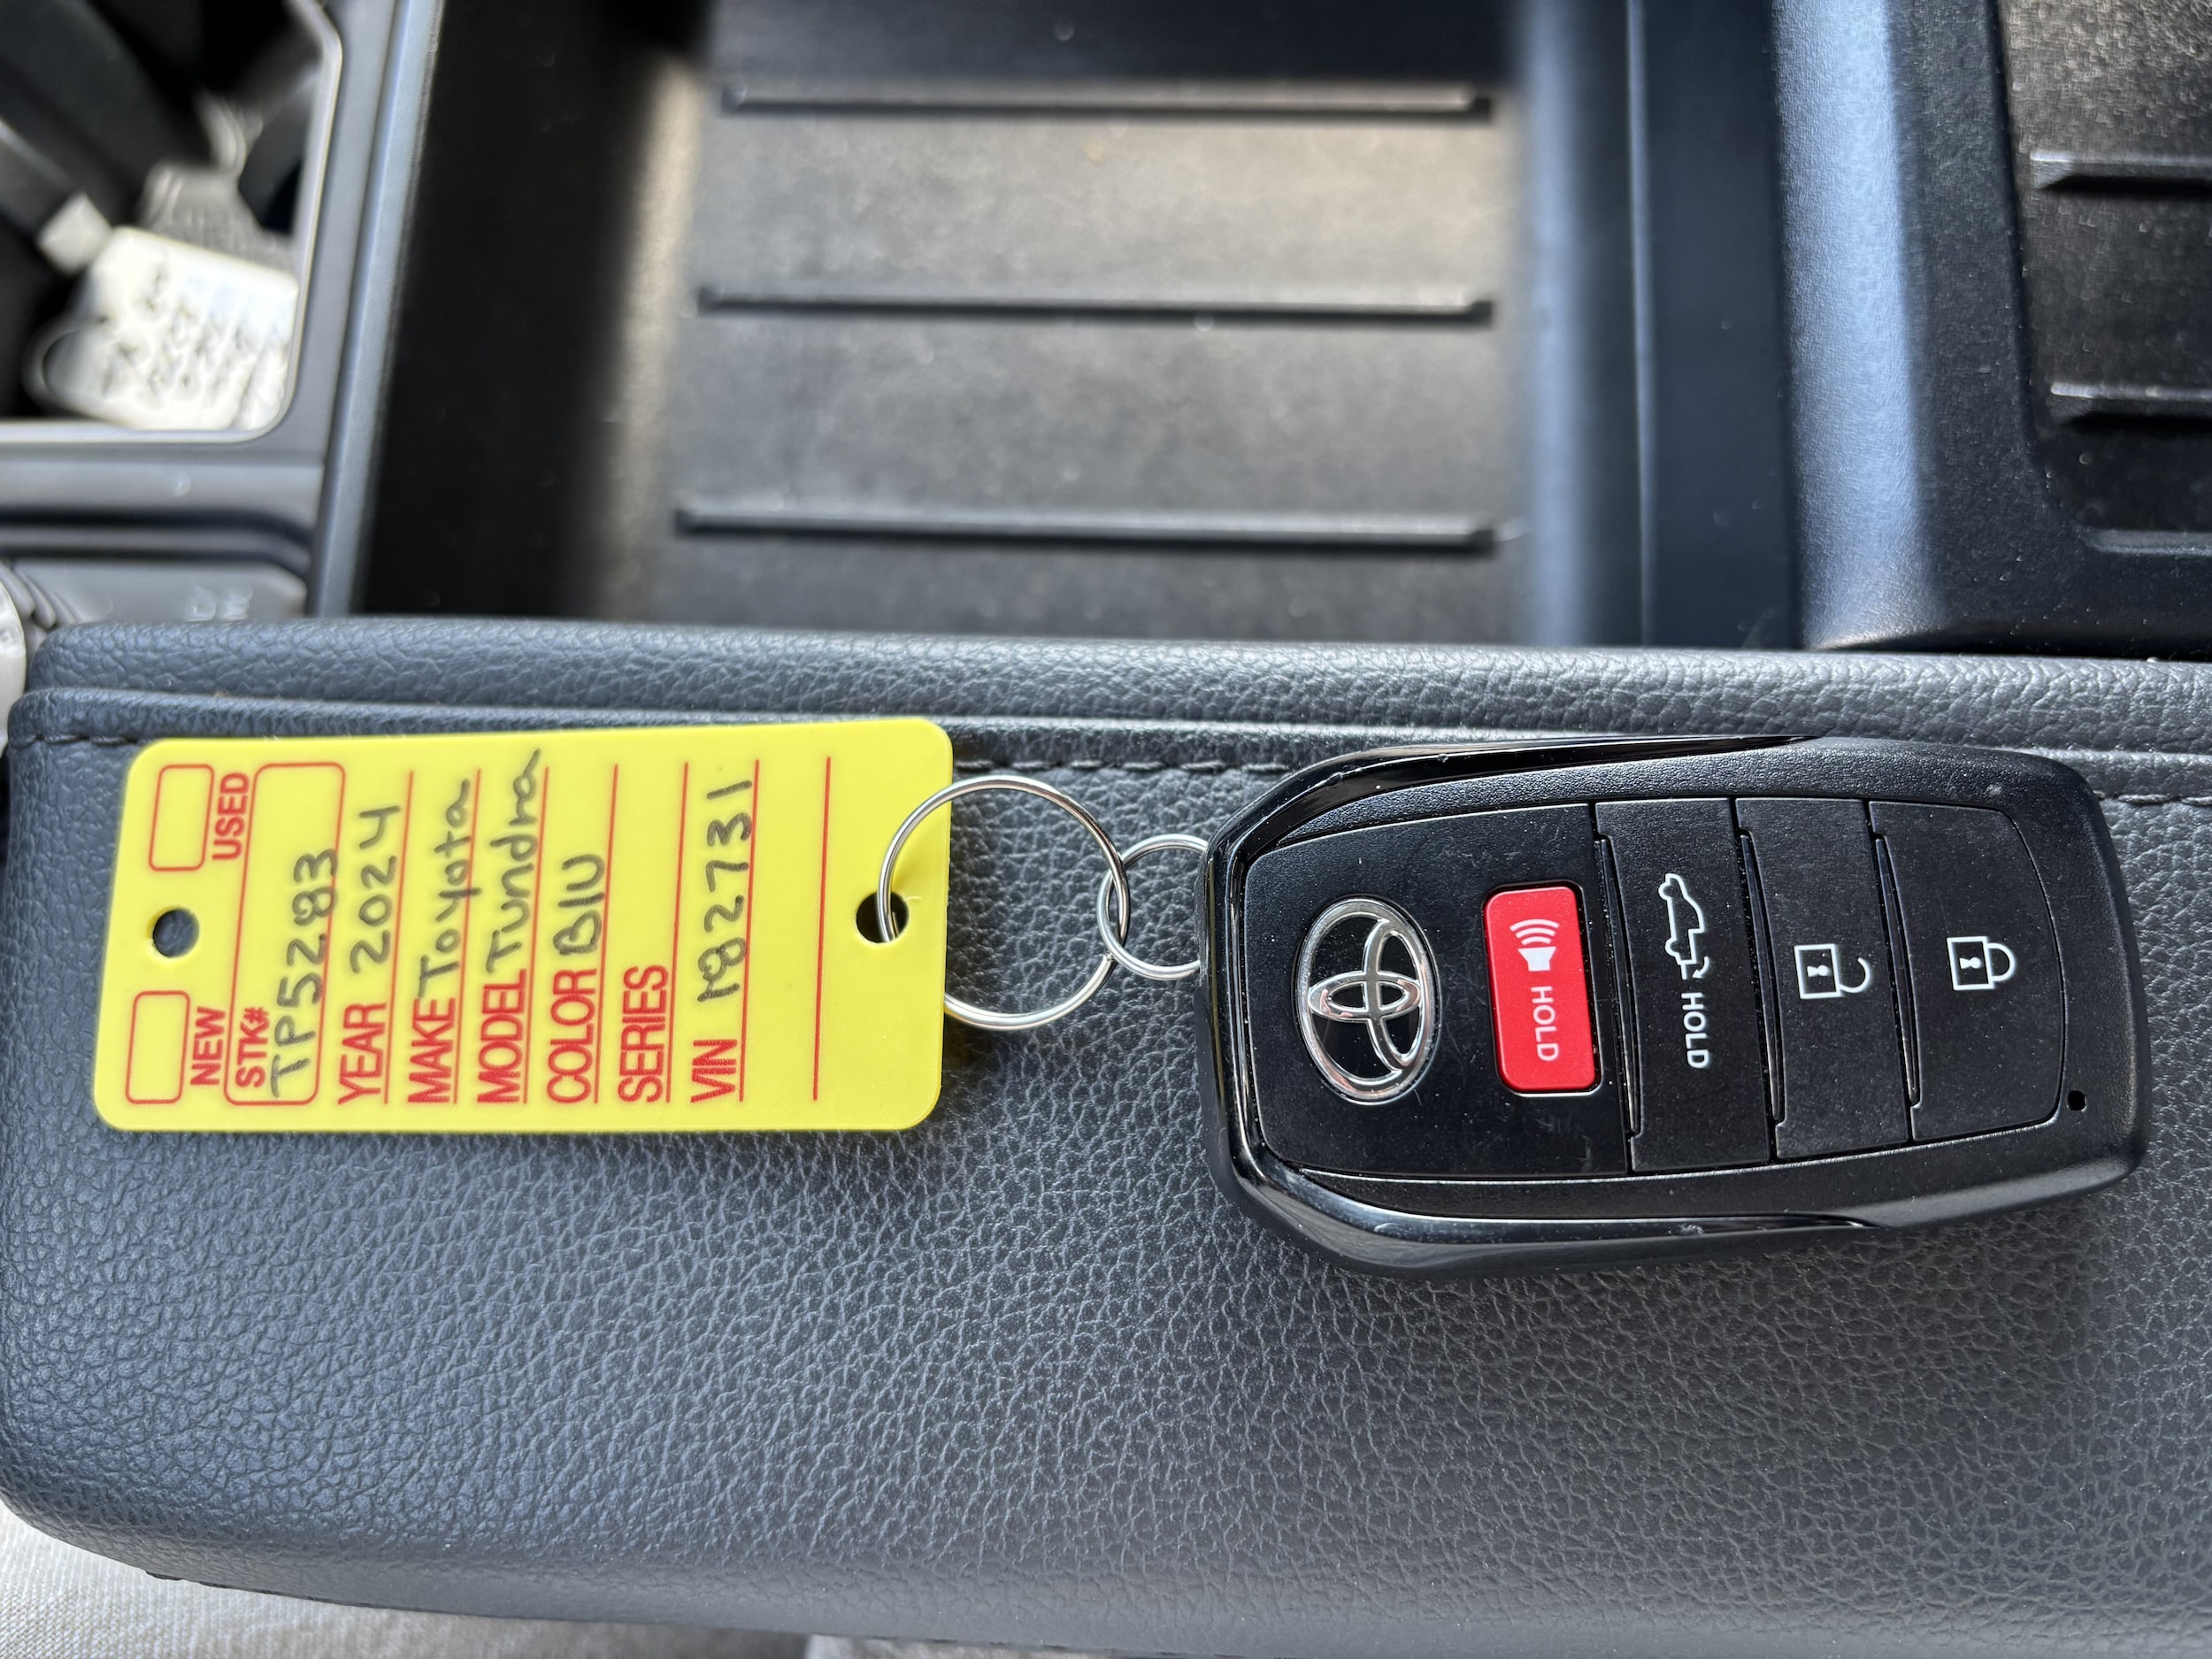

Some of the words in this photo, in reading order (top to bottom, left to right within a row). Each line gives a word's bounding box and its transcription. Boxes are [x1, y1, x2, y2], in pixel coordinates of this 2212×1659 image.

[212, 772, 250, 860] USED
[486, 749, 541, 973] Tundra
[350, 805, 401, 973] 2024
[418, 779, 481, 998] Toyota
[697, 780, 753, 1002] 182731
[271, 848, 338, 1097] TP5283
[1530, 986, 1560, 1062] HOLD
[1680, 992, 1710, 1069] HOLD
[190, 1006, 227, 1086] NEW
[236, 1007, 270, 1087] STK#
[338, 1002, 387, 1104] YEAR
[407, 997, 456, 1103] MAKE
[477, 969, 527, 1103] MODEL
[547, 969, 597, 1103] COLOR
[618, 964, 669, 1103] SERIES
[690, 1039, 738, 1103] VIN
